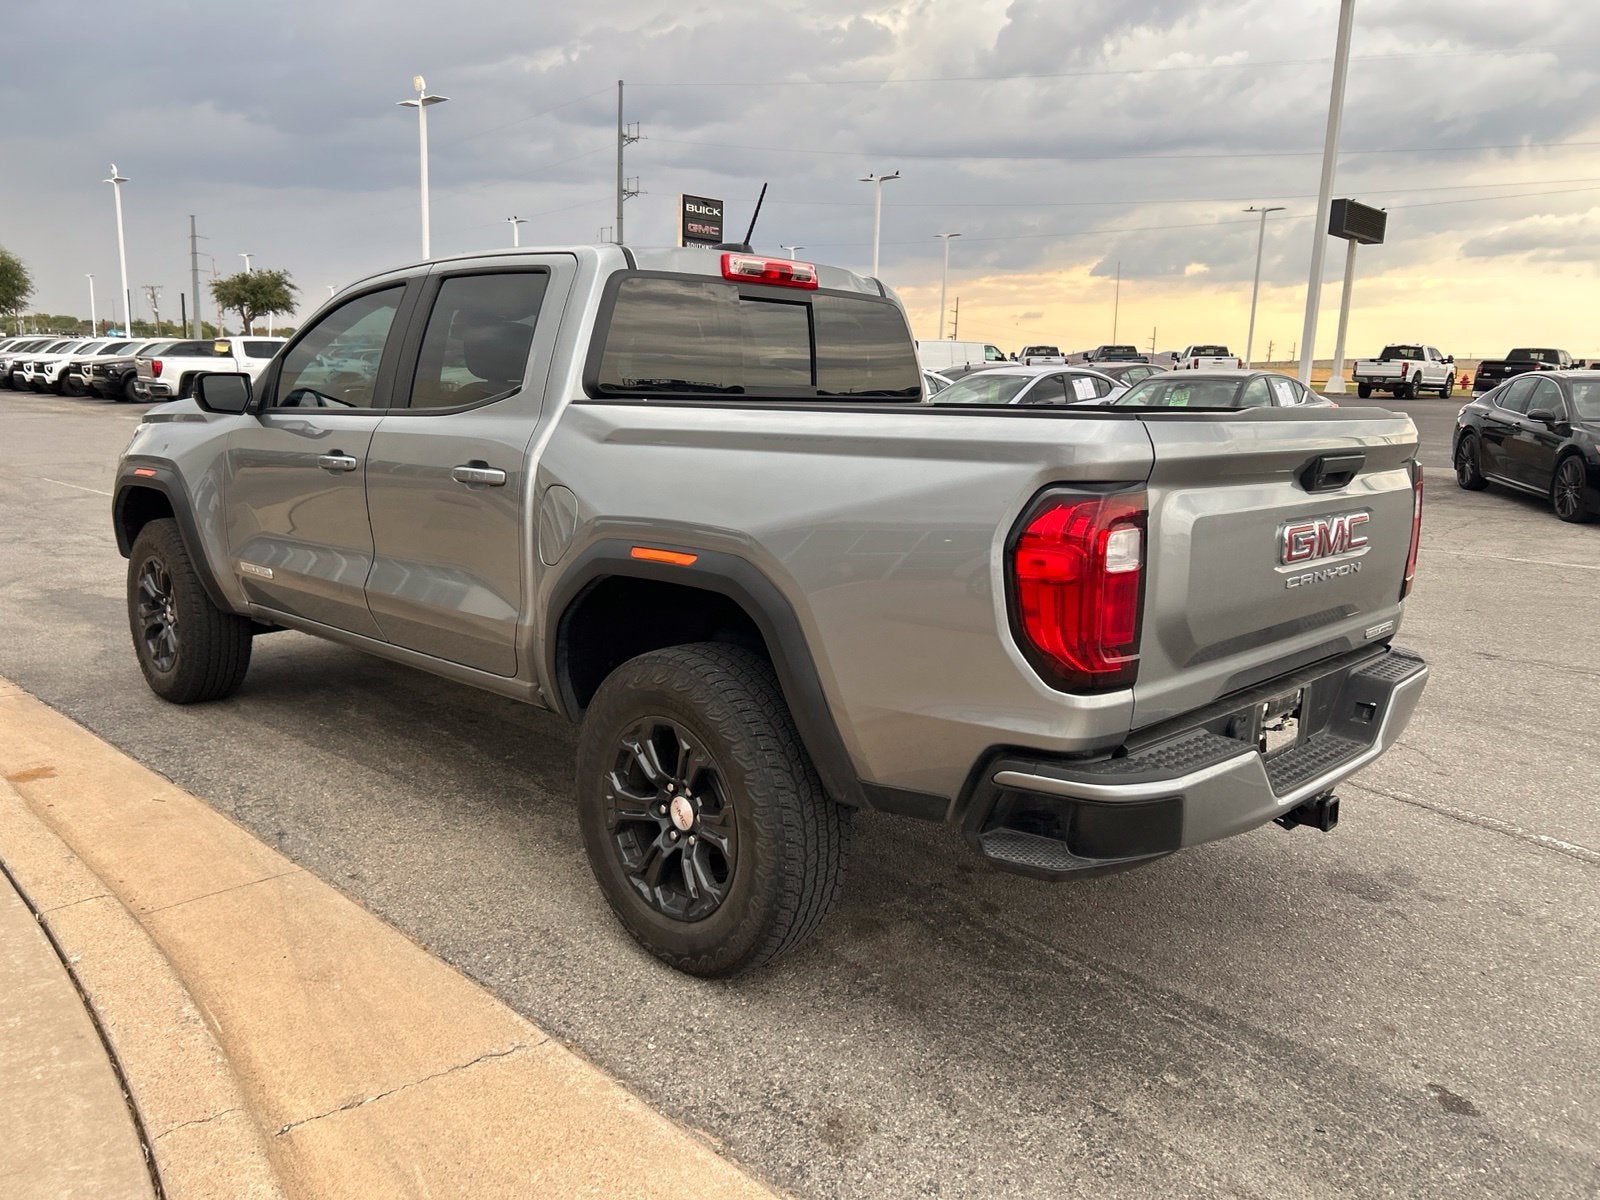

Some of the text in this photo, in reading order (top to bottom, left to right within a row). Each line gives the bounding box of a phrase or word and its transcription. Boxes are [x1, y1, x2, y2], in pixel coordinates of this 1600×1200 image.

[686, 203, 721, 216] BUICK
[687, 223, 719, 235] GMC
[1282, 512, 1370, 565] GMC
[1285, 562, 1362, 589] CANYON
